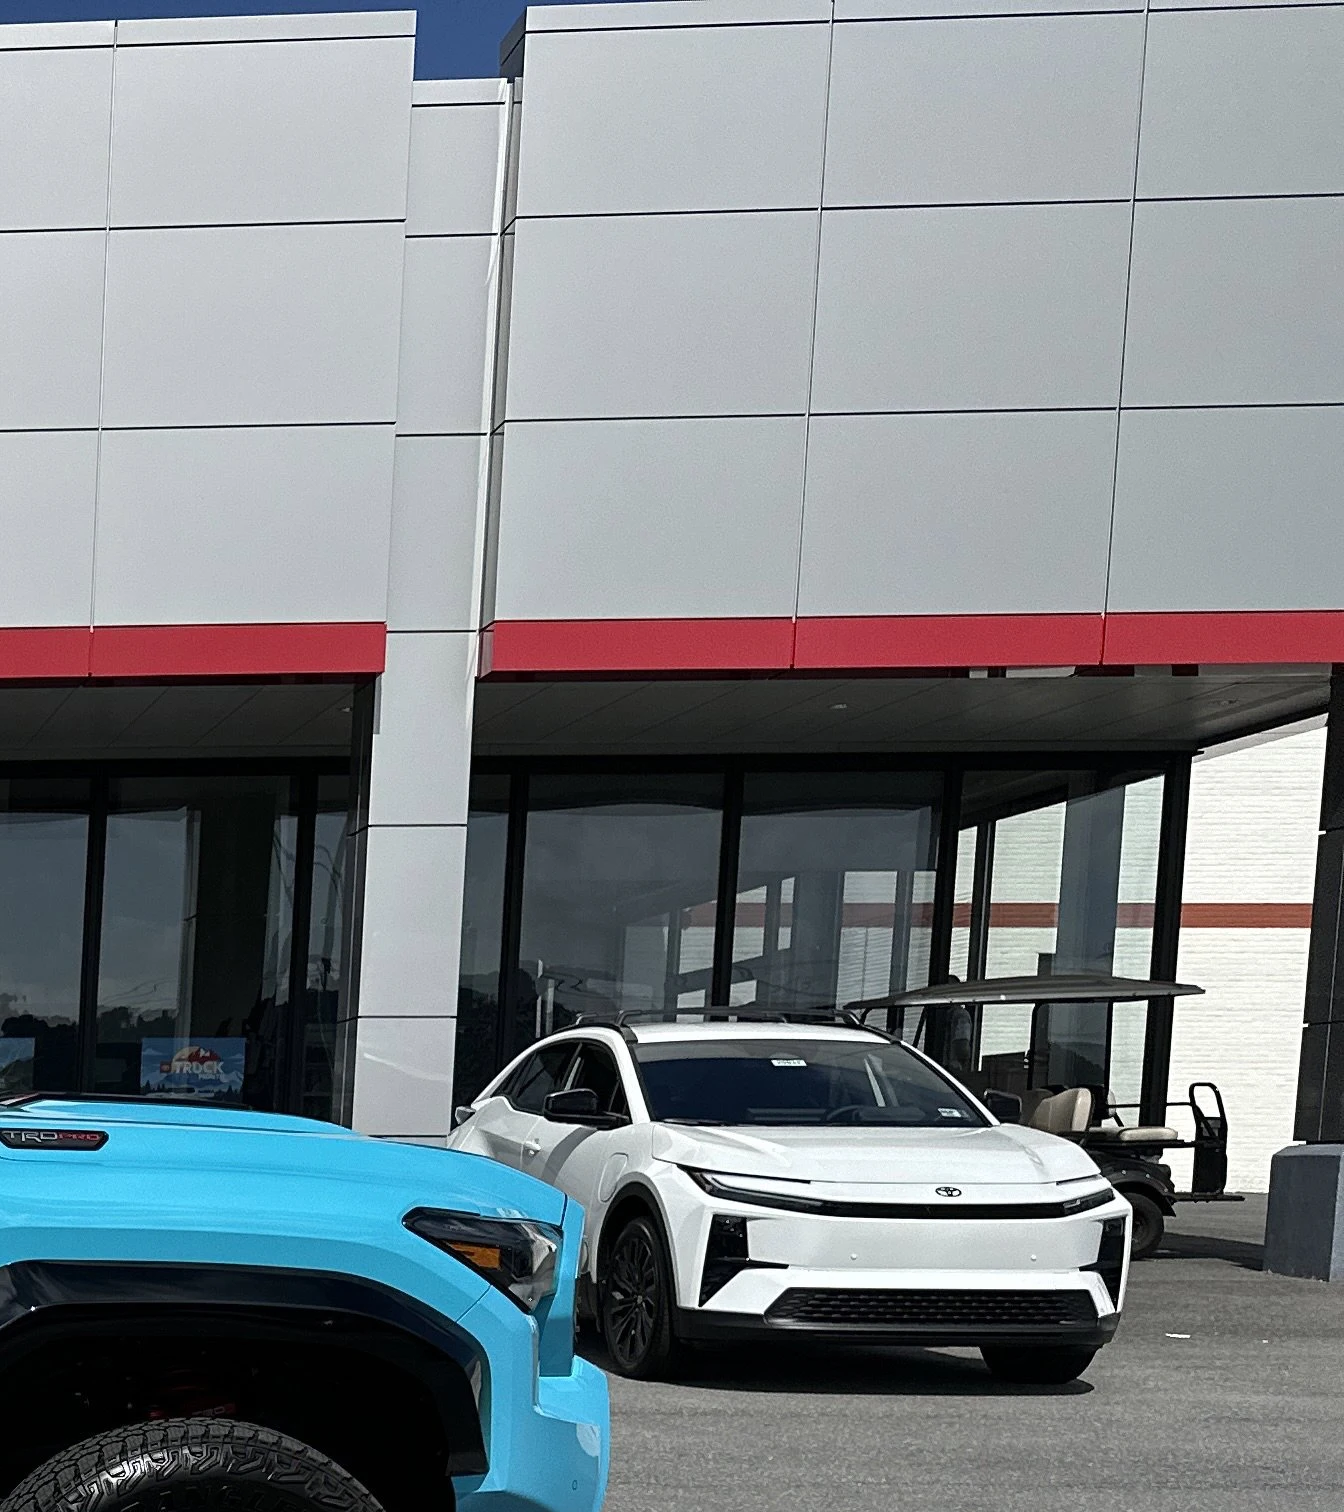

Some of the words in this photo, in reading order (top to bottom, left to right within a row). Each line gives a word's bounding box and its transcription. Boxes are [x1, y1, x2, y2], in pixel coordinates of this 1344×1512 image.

[174, 1061, 225, 1074] TRUCK
[2, 1130, 58, 1143] TRD
[58, 1132, 100, 1141] PRO
